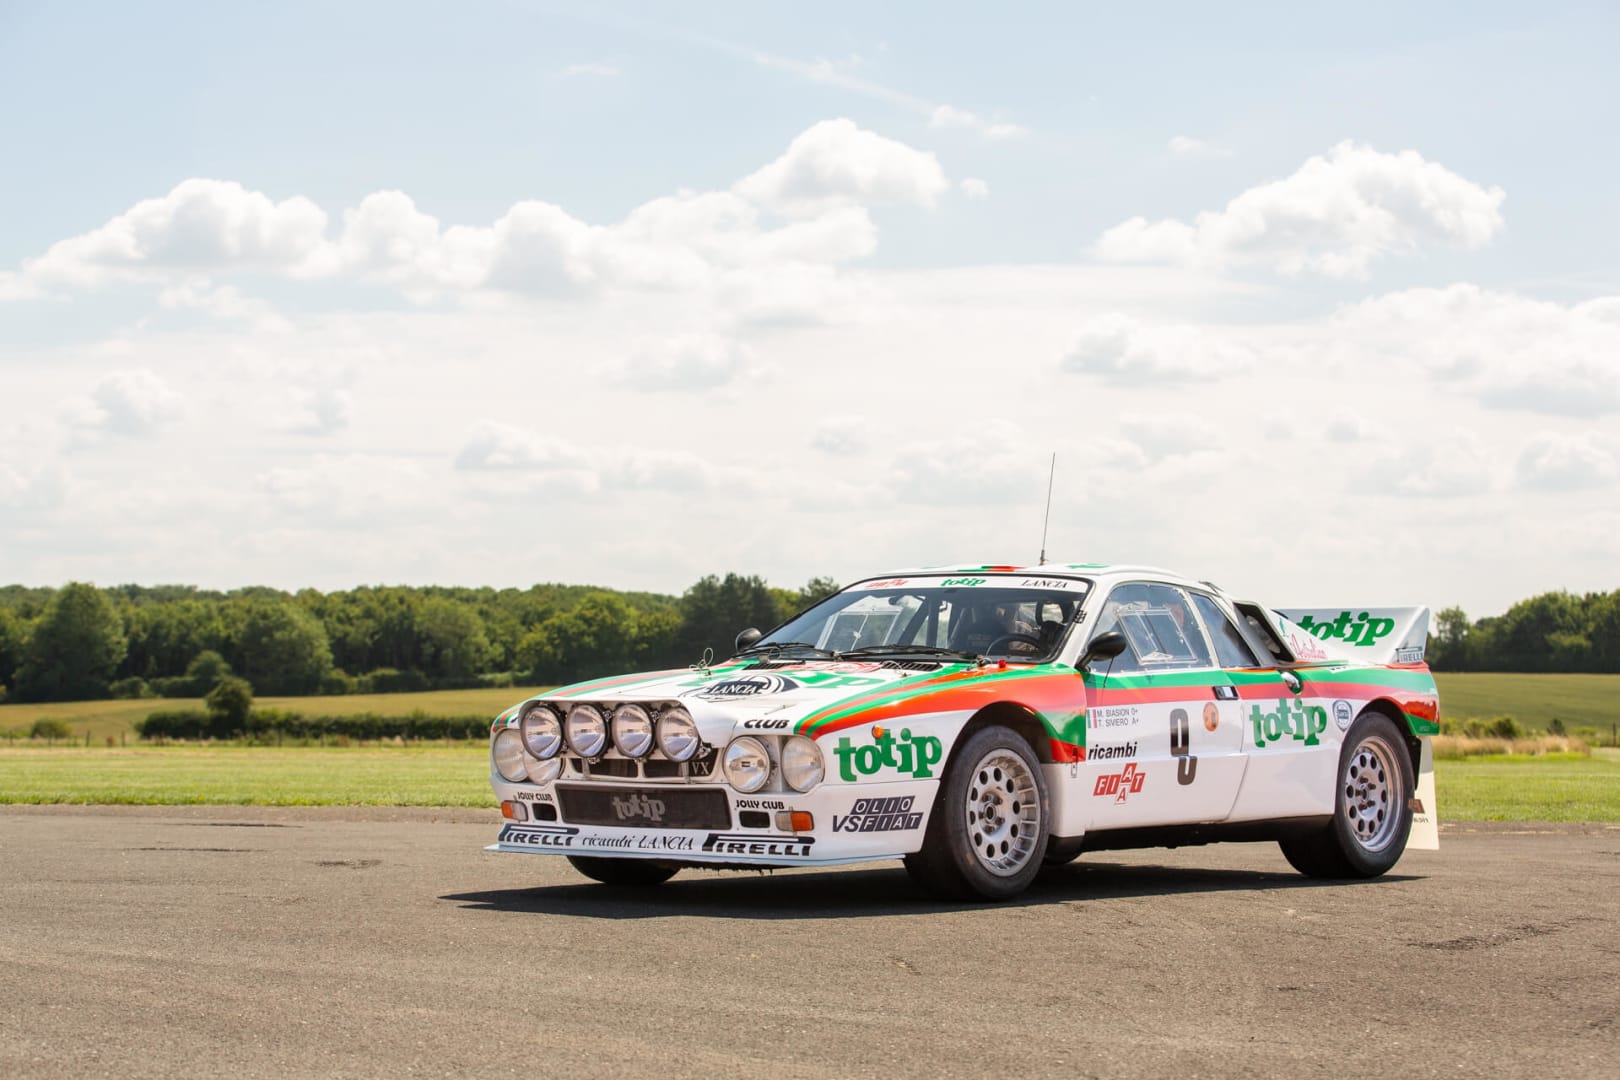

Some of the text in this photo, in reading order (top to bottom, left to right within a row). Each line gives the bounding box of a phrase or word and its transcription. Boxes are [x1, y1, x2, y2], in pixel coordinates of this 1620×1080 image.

[941, 577, 986, 587] totip
[1021, 578, 1068, 588] LANCIA
[1296, 611, 1395, 647] totip
[711, 683, 757, 695] LANCIA
[1105, 708, 1130, 717] BIASION
[744, 719, 790, 729] CLUB
[1249, 698, 1327, 748] totip
[833, 727, 942, 782] totip
[1088, 741, 1138, 760] ricambi
[692, 762, 709, 776] VX
[517, 791, 553, 802] JOLLY CLUB
[612, 794, 666, 823] totip
[736, 799, 784, 810] JOLLY CLUB
[852, 797, 914, 814] OLIO
[498, 823, 816, 857] PIRELLI ricambi LANCIA PIRELLI
